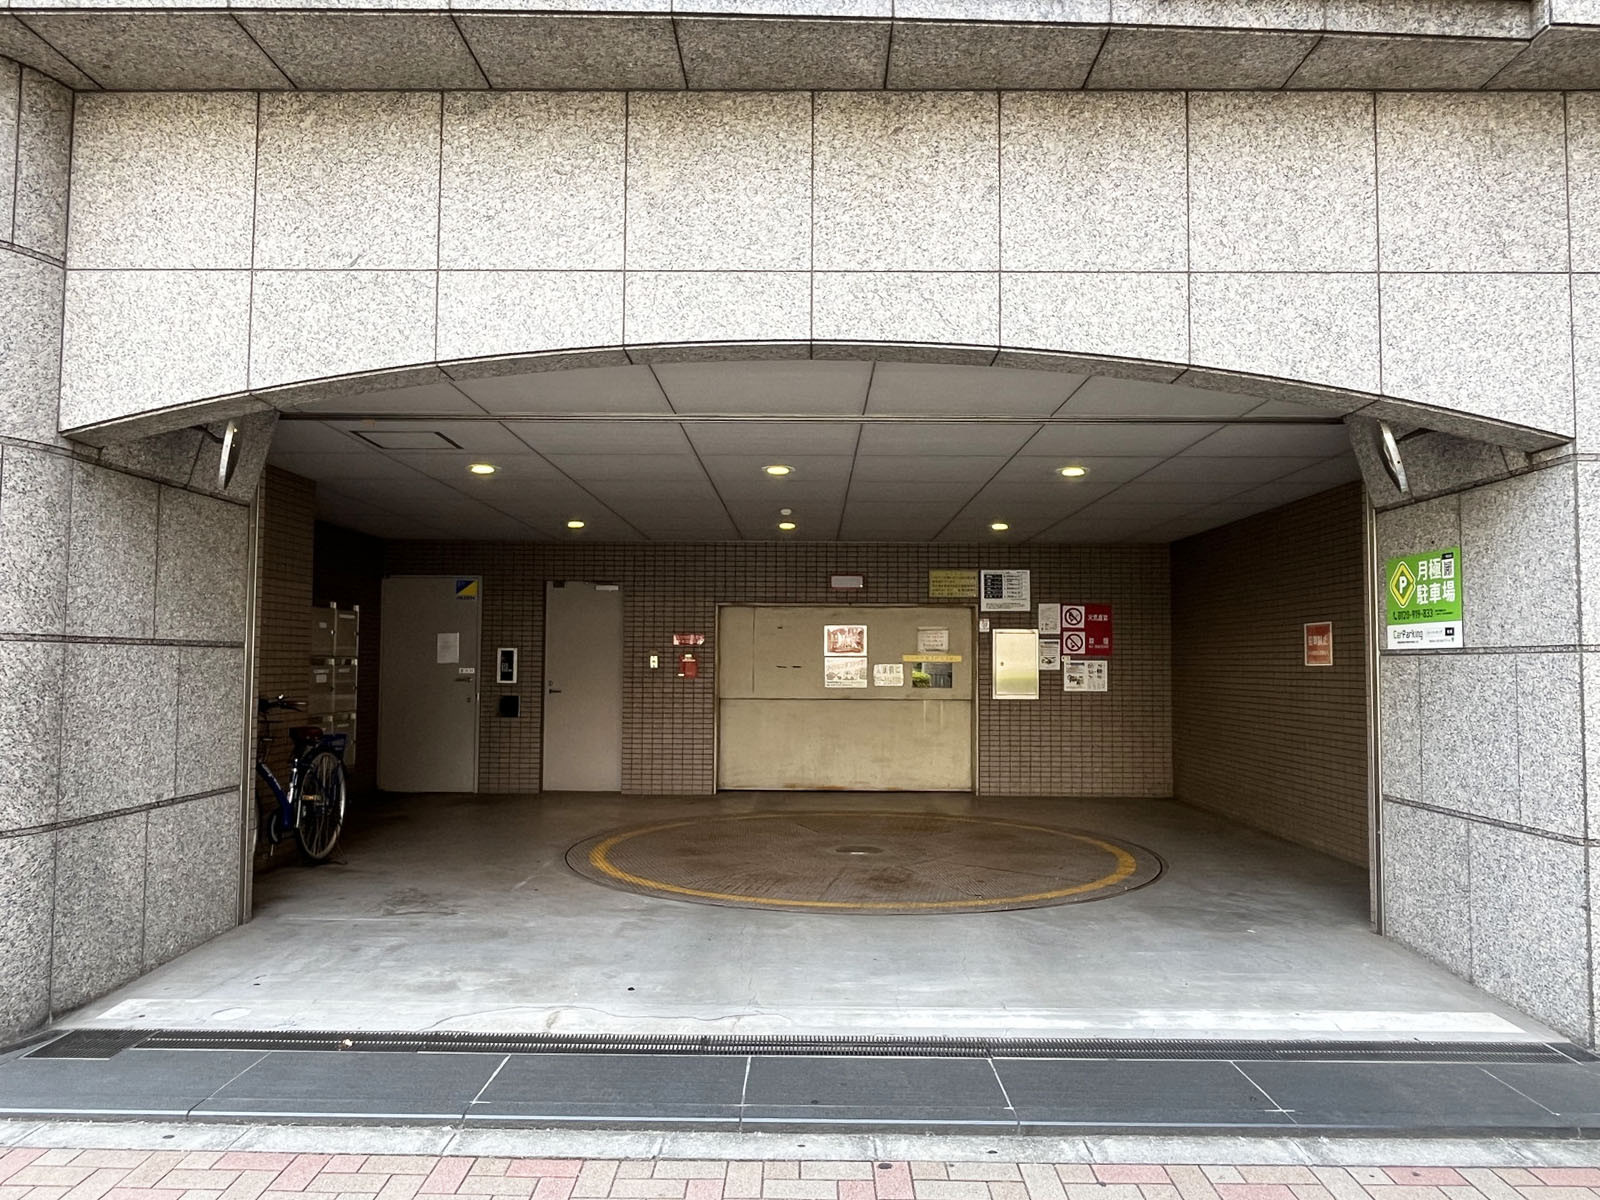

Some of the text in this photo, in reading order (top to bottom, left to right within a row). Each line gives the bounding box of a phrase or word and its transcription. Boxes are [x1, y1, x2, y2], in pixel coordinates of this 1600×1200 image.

[1417, 557, 1441, 581] 月極
[1399, 576, 1407, 594] P
[1416, 580, 1455, 605] 駐車場
